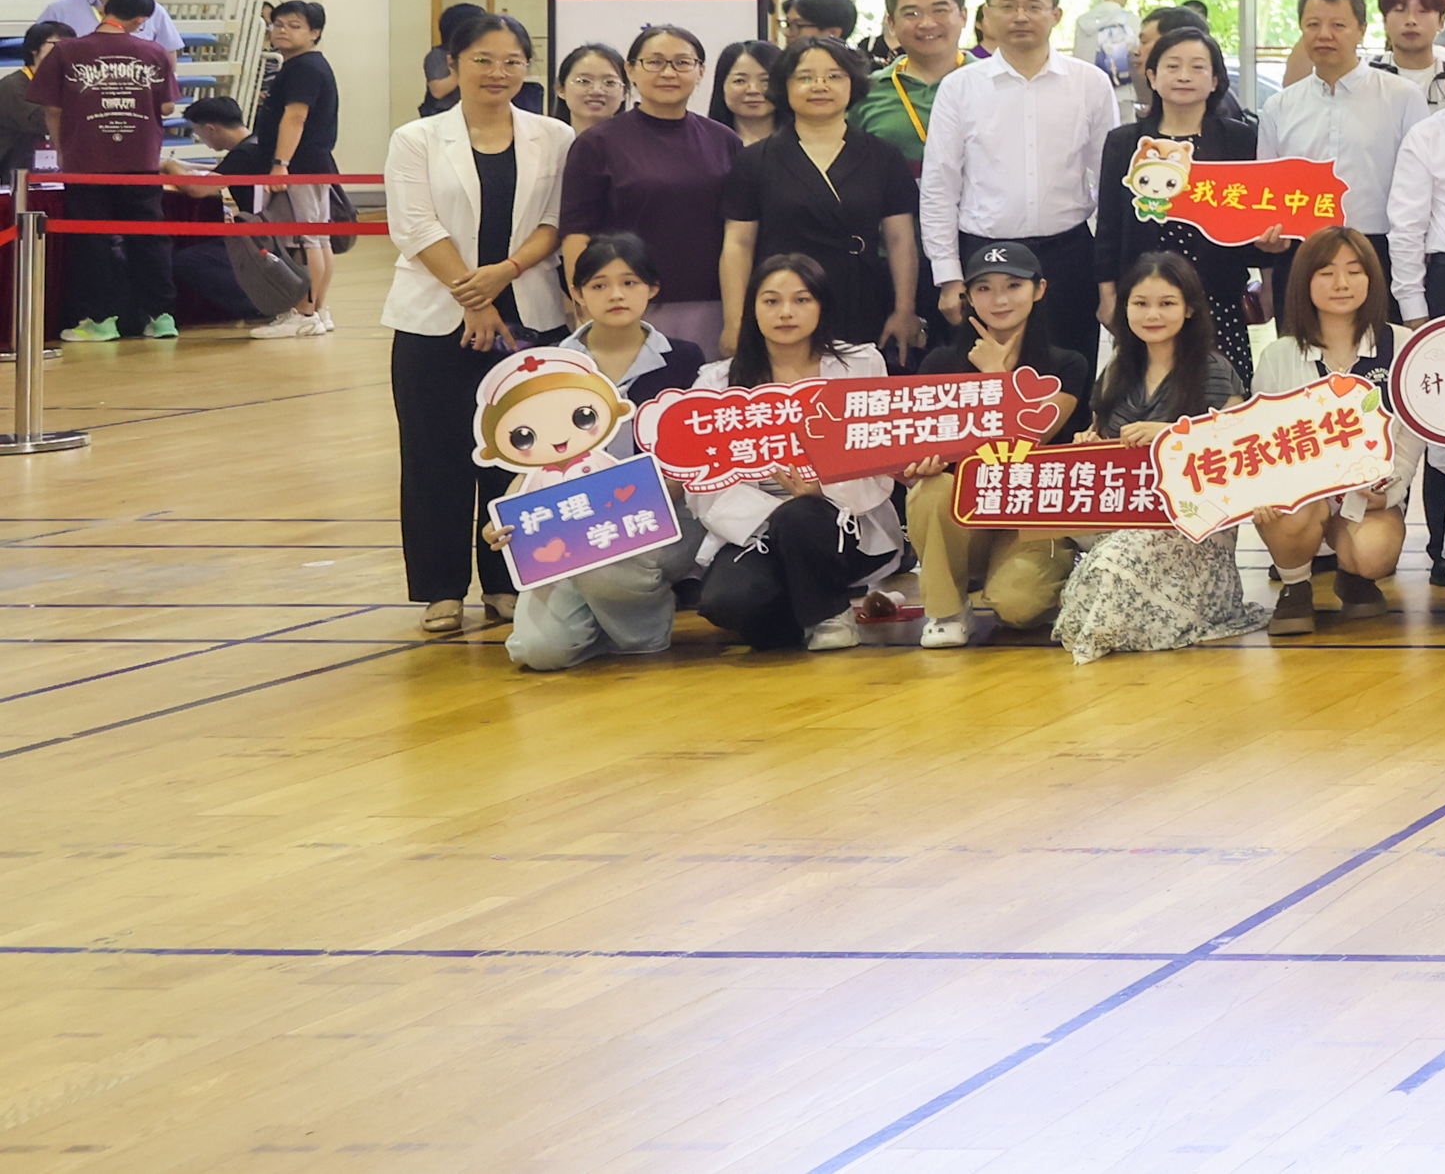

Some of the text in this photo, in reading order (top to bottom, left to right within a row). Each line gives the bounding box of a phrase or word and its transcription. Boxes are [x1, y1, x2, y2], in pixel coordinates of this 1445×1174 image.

[1189, 178, 1336, 218] 我爱上中医
[684, 398, 803, 436] 七秩荣光
[844, 378, 1004, 419] 用奋斗定义青春
[845, 409, 1004, 451] 用实干丈量人生
[1182, 406, 1365, 494] 传承精华
[518, 492, 596, 536] 护理
[586, 511, 660, 550] 学院
